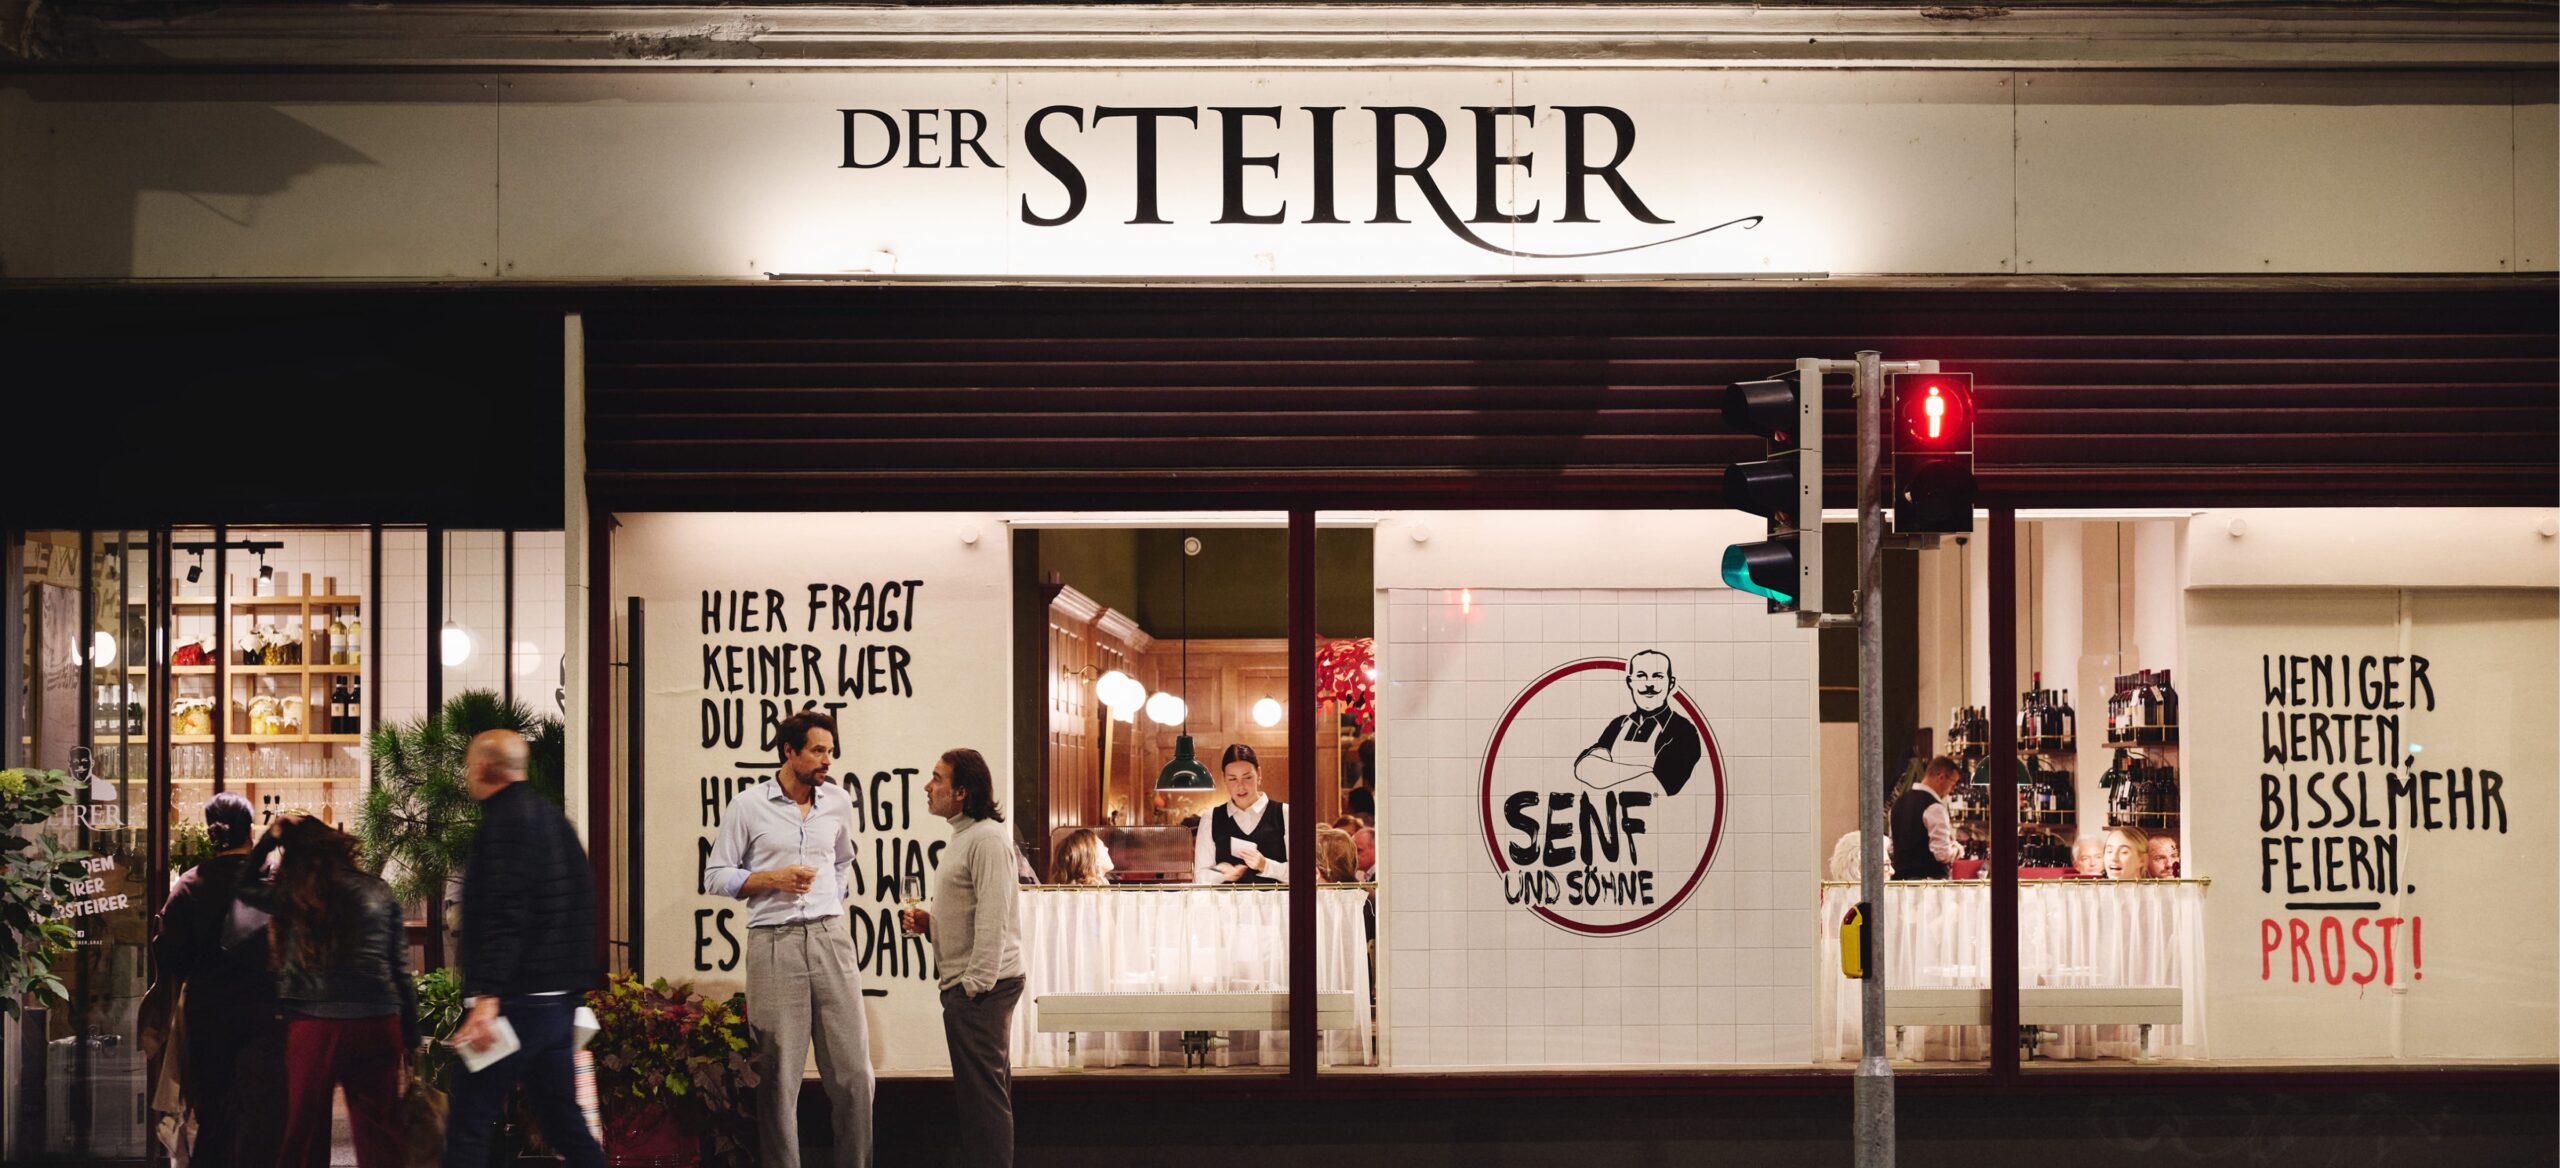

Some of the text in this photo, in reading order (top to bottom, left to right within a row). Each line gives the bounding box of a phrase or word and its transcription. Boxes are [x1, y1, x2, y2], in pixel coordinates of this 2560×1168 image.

[837, 104, 1764, 260] DER STEIRER
[701, 580, 924, 636] HIER FRAGT
[702, 643, 913, 699] KEINER WER
[2263, 653, 2436, 712] WENIGER
[701, 698, 848, 759] DU BT
[1503, 790, 1653, 867] SENF
[1504, 865, 1655, 906] UND SÖHNE
[2261, 833, 2416, 896] FEIERN.
[694, 904, 941, 981] ES DAR
[2261, 916, 2423, 988] PROST!
